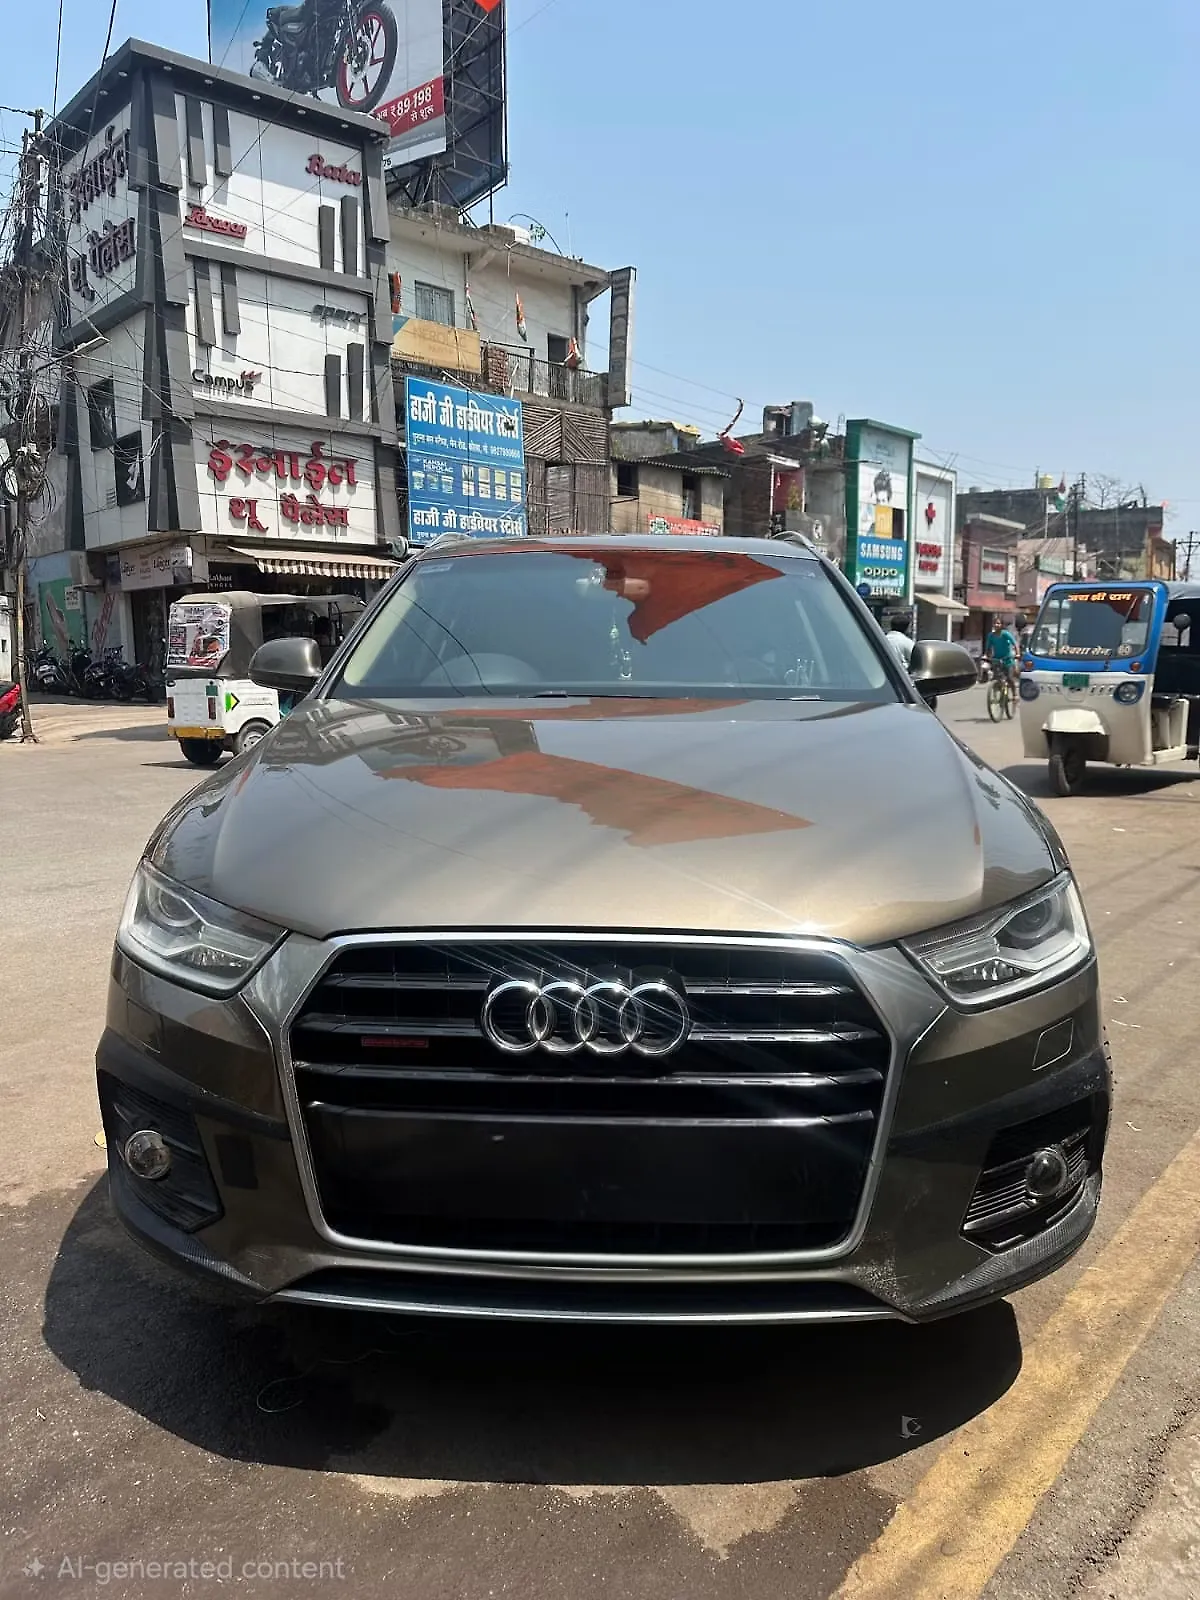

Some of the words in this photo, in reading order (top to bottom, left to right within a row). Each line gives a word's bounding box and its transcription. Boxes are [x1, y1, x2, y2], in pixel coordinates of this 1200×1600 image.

[305, 153, 362, 186] Bata
[229, 497, 269, 532] शू
[279, 491, 350, 527] पैलेस
[413, 507, 440, 527] हाजी
[441, 508, 457, 529] जी
[860, 542, 903, 561] SAMSUNG
